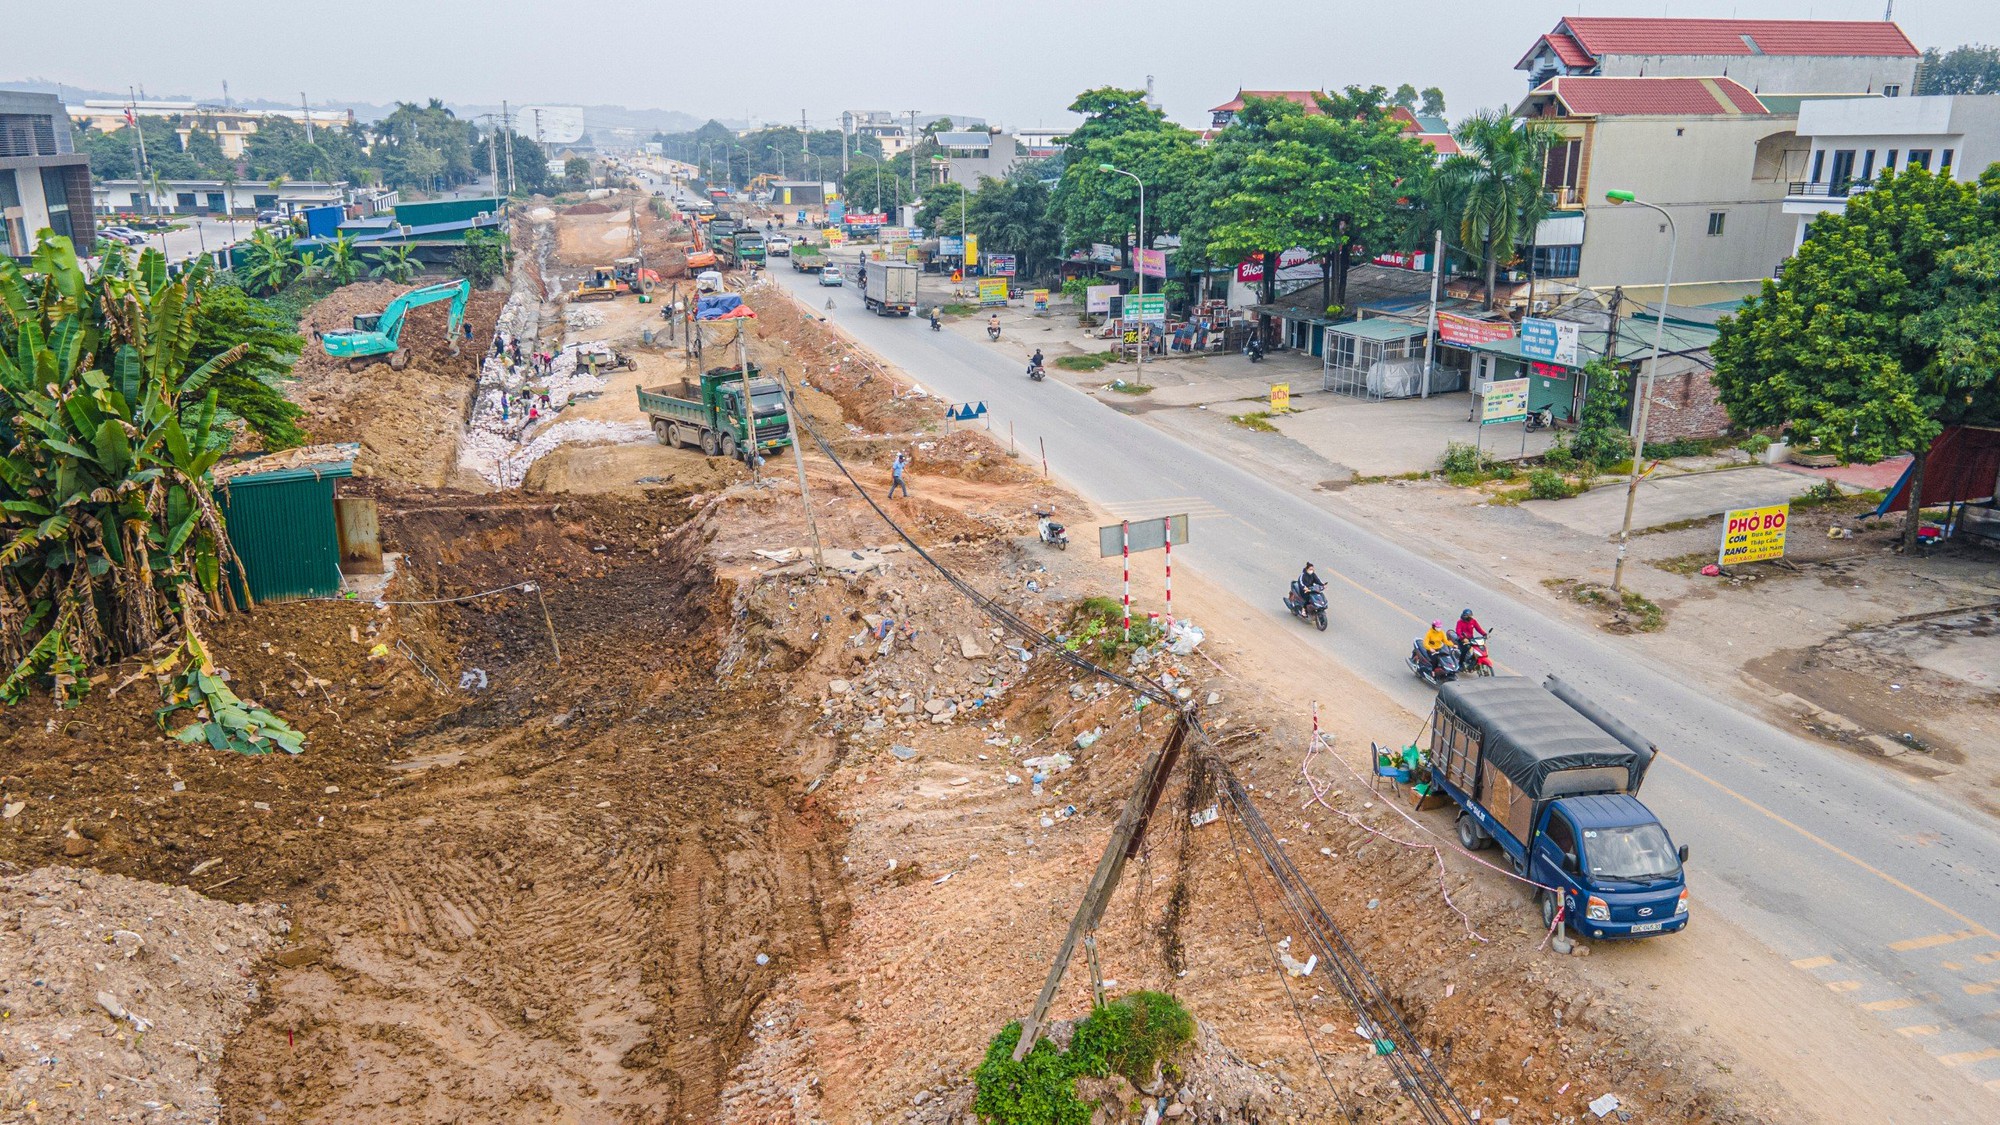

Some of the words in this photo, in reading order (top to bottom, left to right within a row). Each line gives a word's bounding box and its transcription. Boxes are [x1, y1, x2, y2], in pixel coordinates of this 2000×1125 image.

[1729, 512, 1760, 534] PHỞ
[1764, 510, 1785, 529] BÒ
[1729, 534, 1747, 544] CƠM
[1724, 547, 1748, 556] RANG
